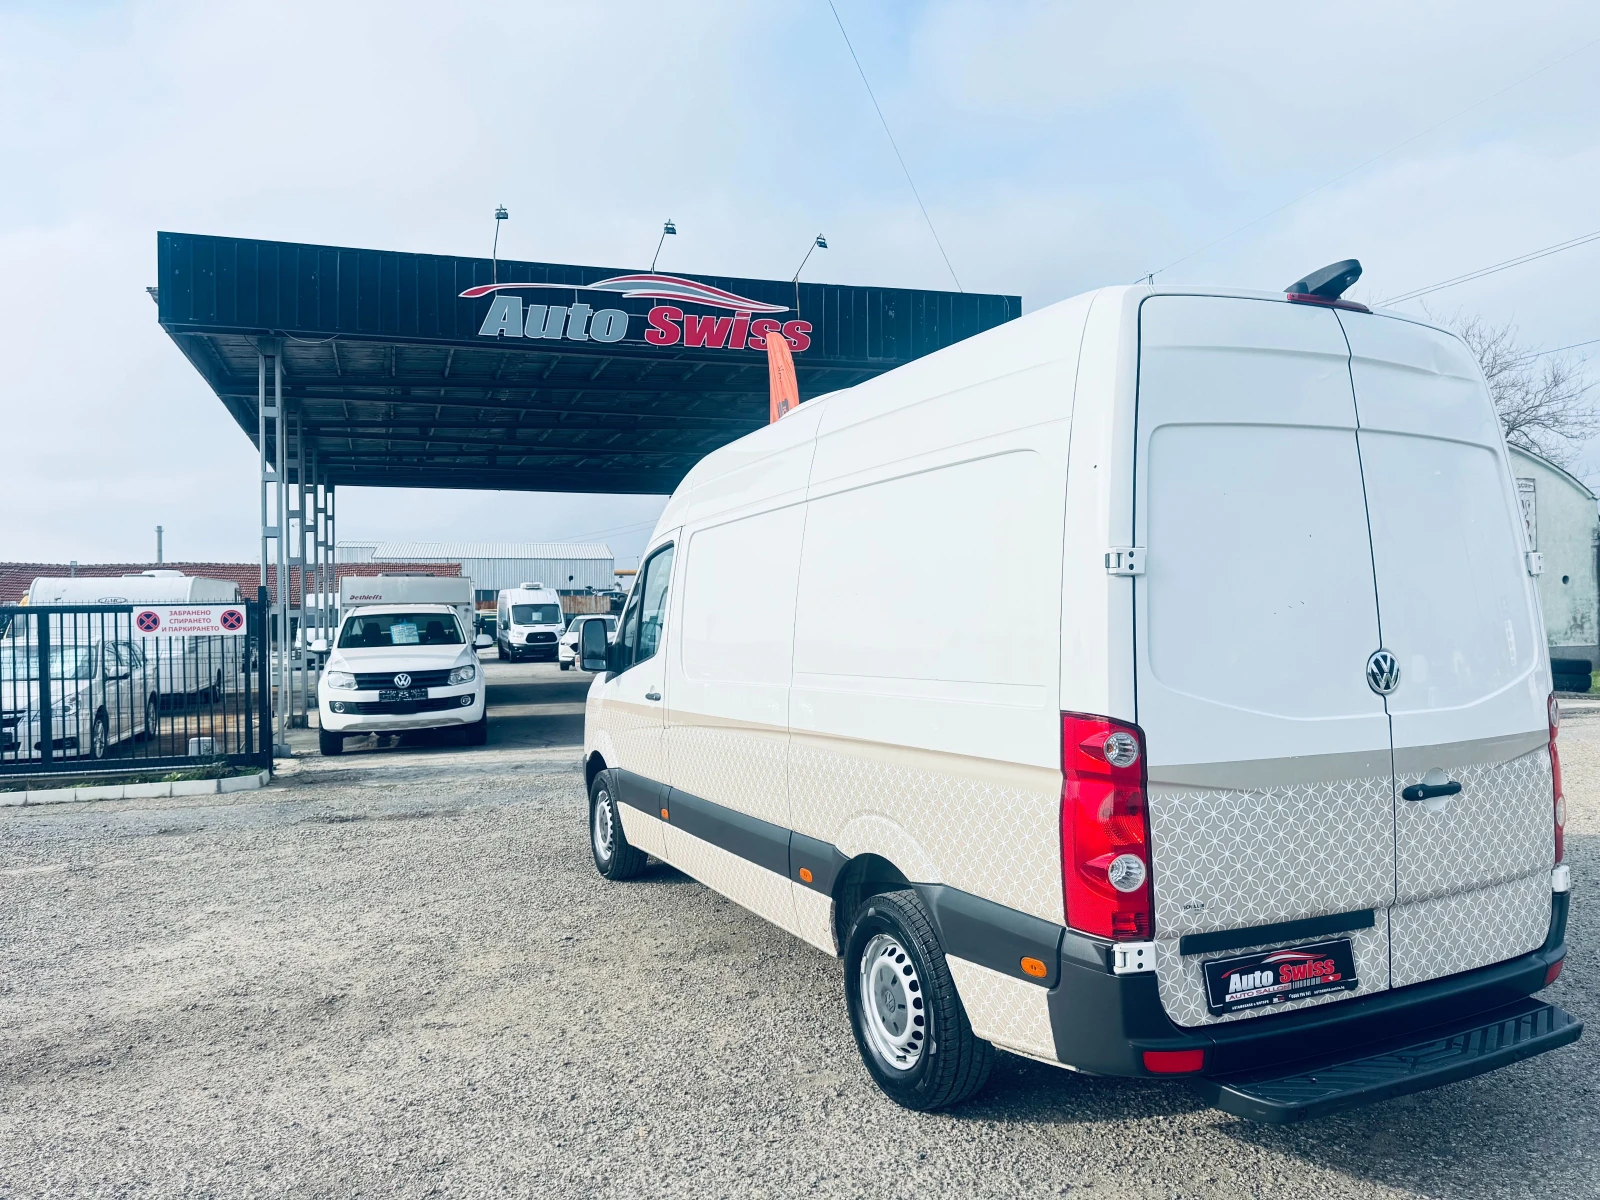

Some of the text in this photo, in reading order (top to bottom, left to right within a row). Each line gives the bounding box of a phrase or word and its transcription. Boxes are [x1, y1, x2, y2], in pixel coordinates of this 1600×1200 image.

[478, 295, 813, 352] Auto Swiss
[1228, 959, 1335, 993] Auto Swiss
[1229, 991, 1254, 1000] AUTO
